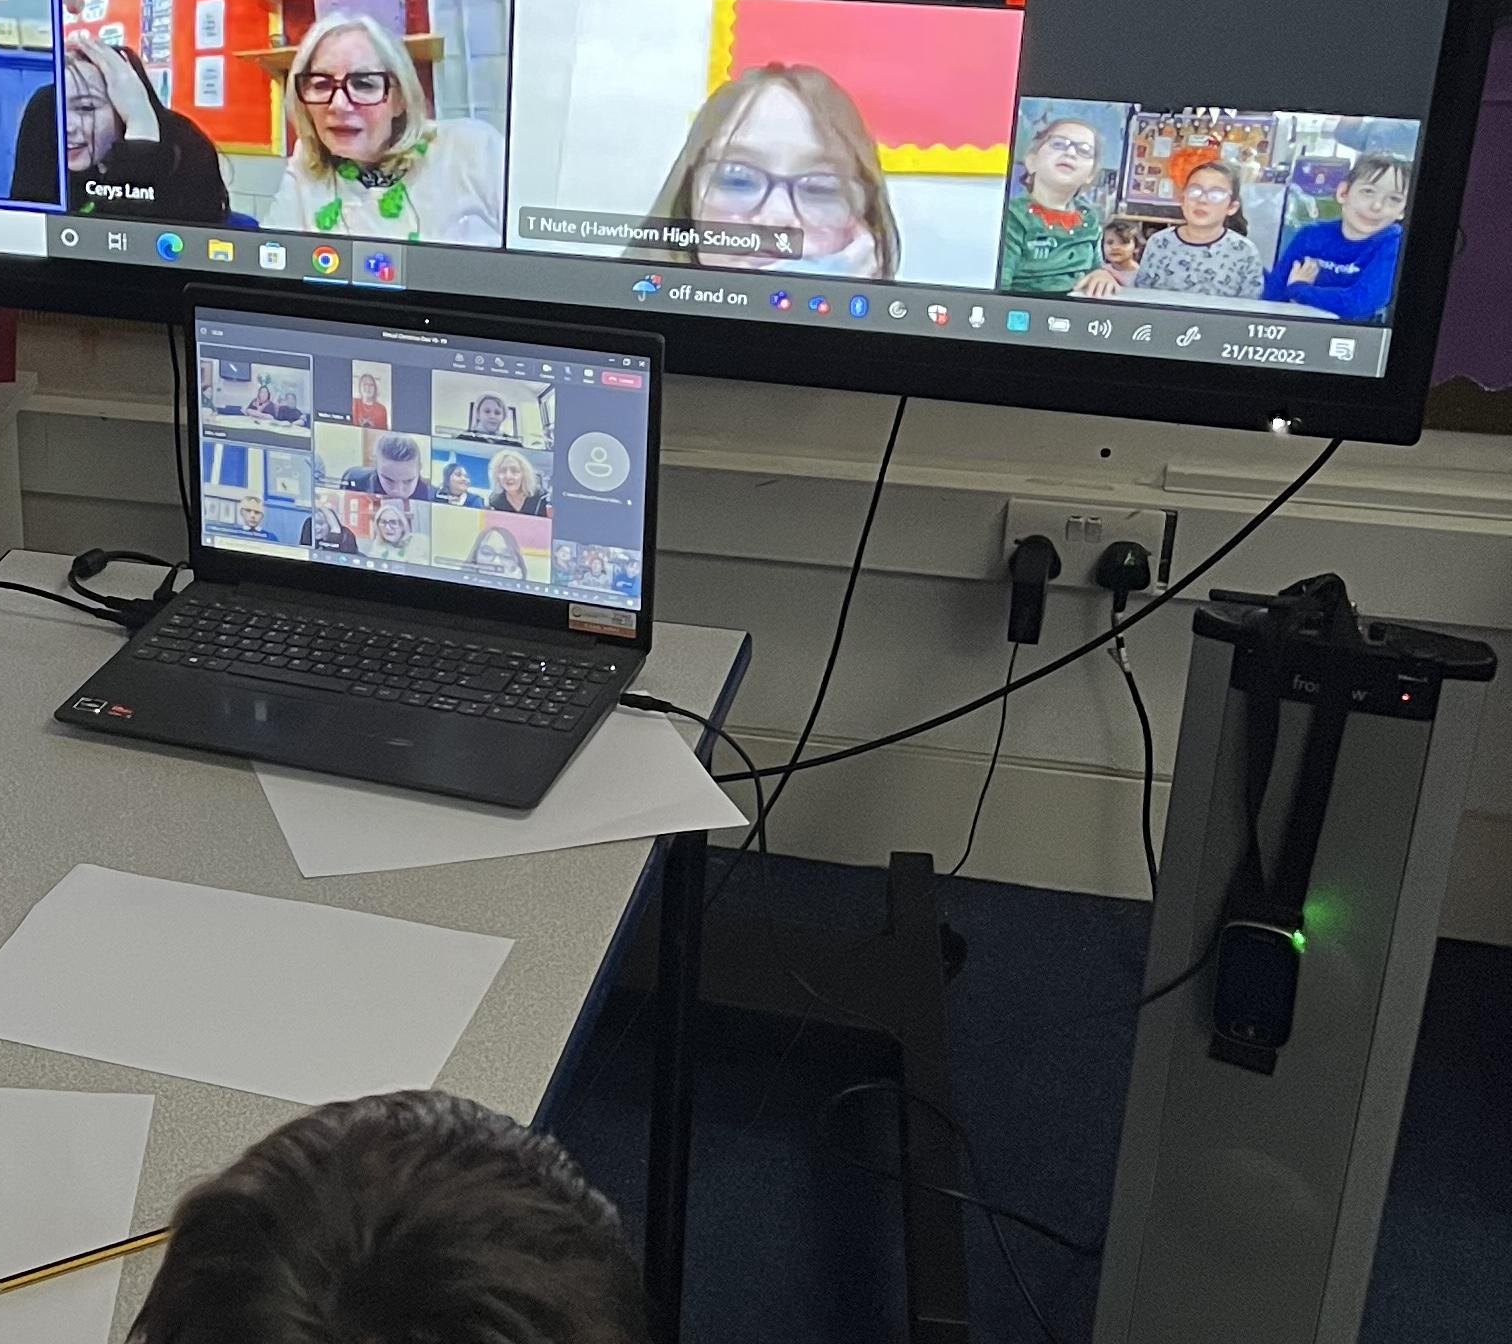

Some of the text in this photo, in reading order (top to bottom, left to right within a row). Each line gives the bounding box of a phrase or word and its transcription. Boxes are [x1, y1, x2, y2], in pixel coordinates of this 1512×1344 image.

[86, 180, 155, 200] Cerys Lant
[527, 216, 761, 252] T Nute (Hawthorn High School)
[669, 286, 748, 305] off and on
[1248, 324, 1287, 340] 11:07
[1221, 343, 1306, 365] 21/12/2022
